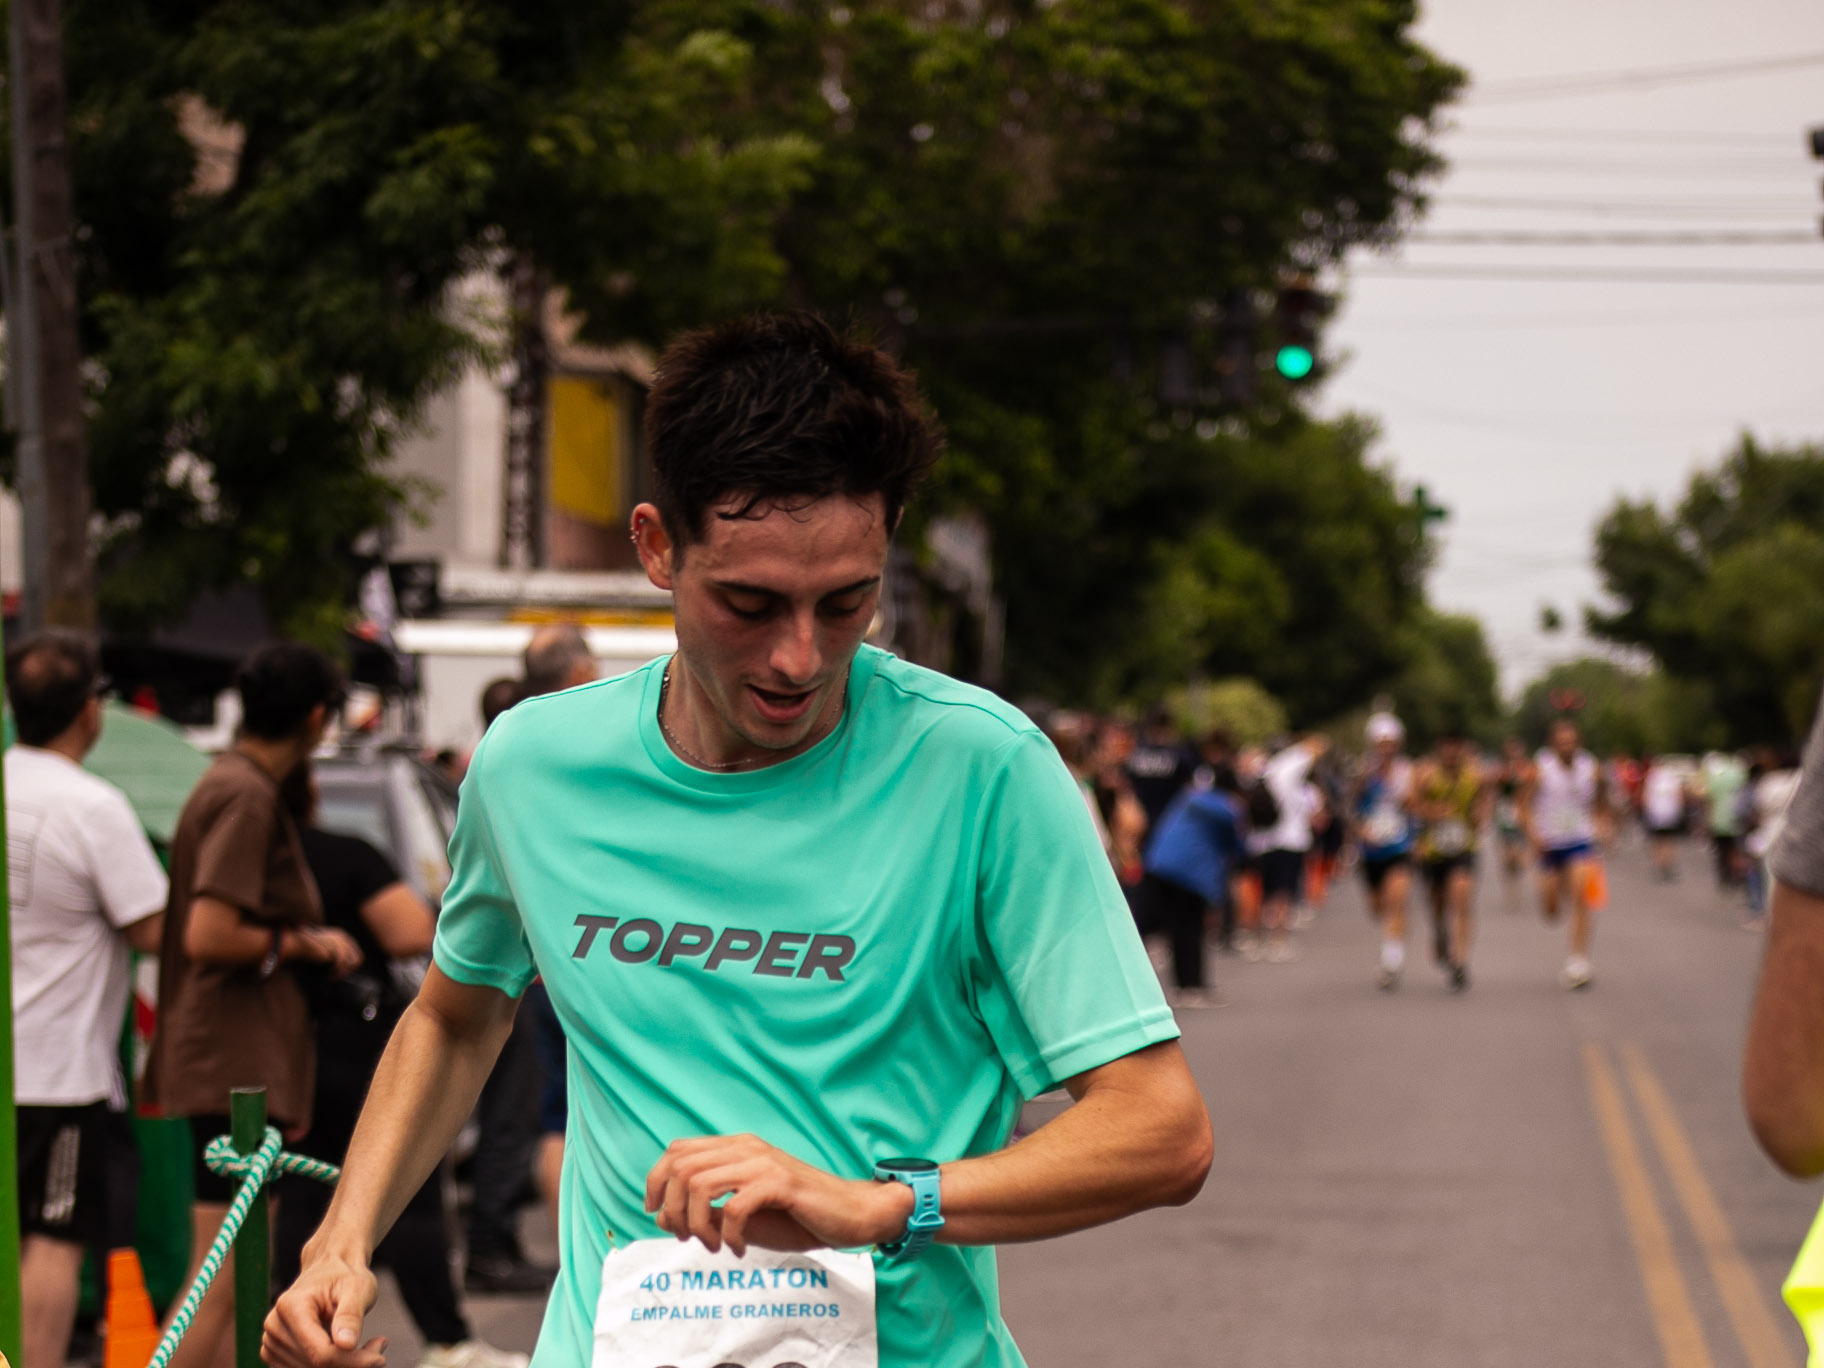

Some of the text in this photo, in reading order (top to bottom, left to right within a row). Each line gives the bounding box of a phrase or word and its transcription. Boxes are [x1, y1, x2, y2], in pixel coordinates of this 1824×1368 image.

[572, 913, 856, 982] TOPPER
[640, 1268, 829, 1291] 40 MARATON
[630, 1303, 840, 1321] EMPALME GRANEROS
